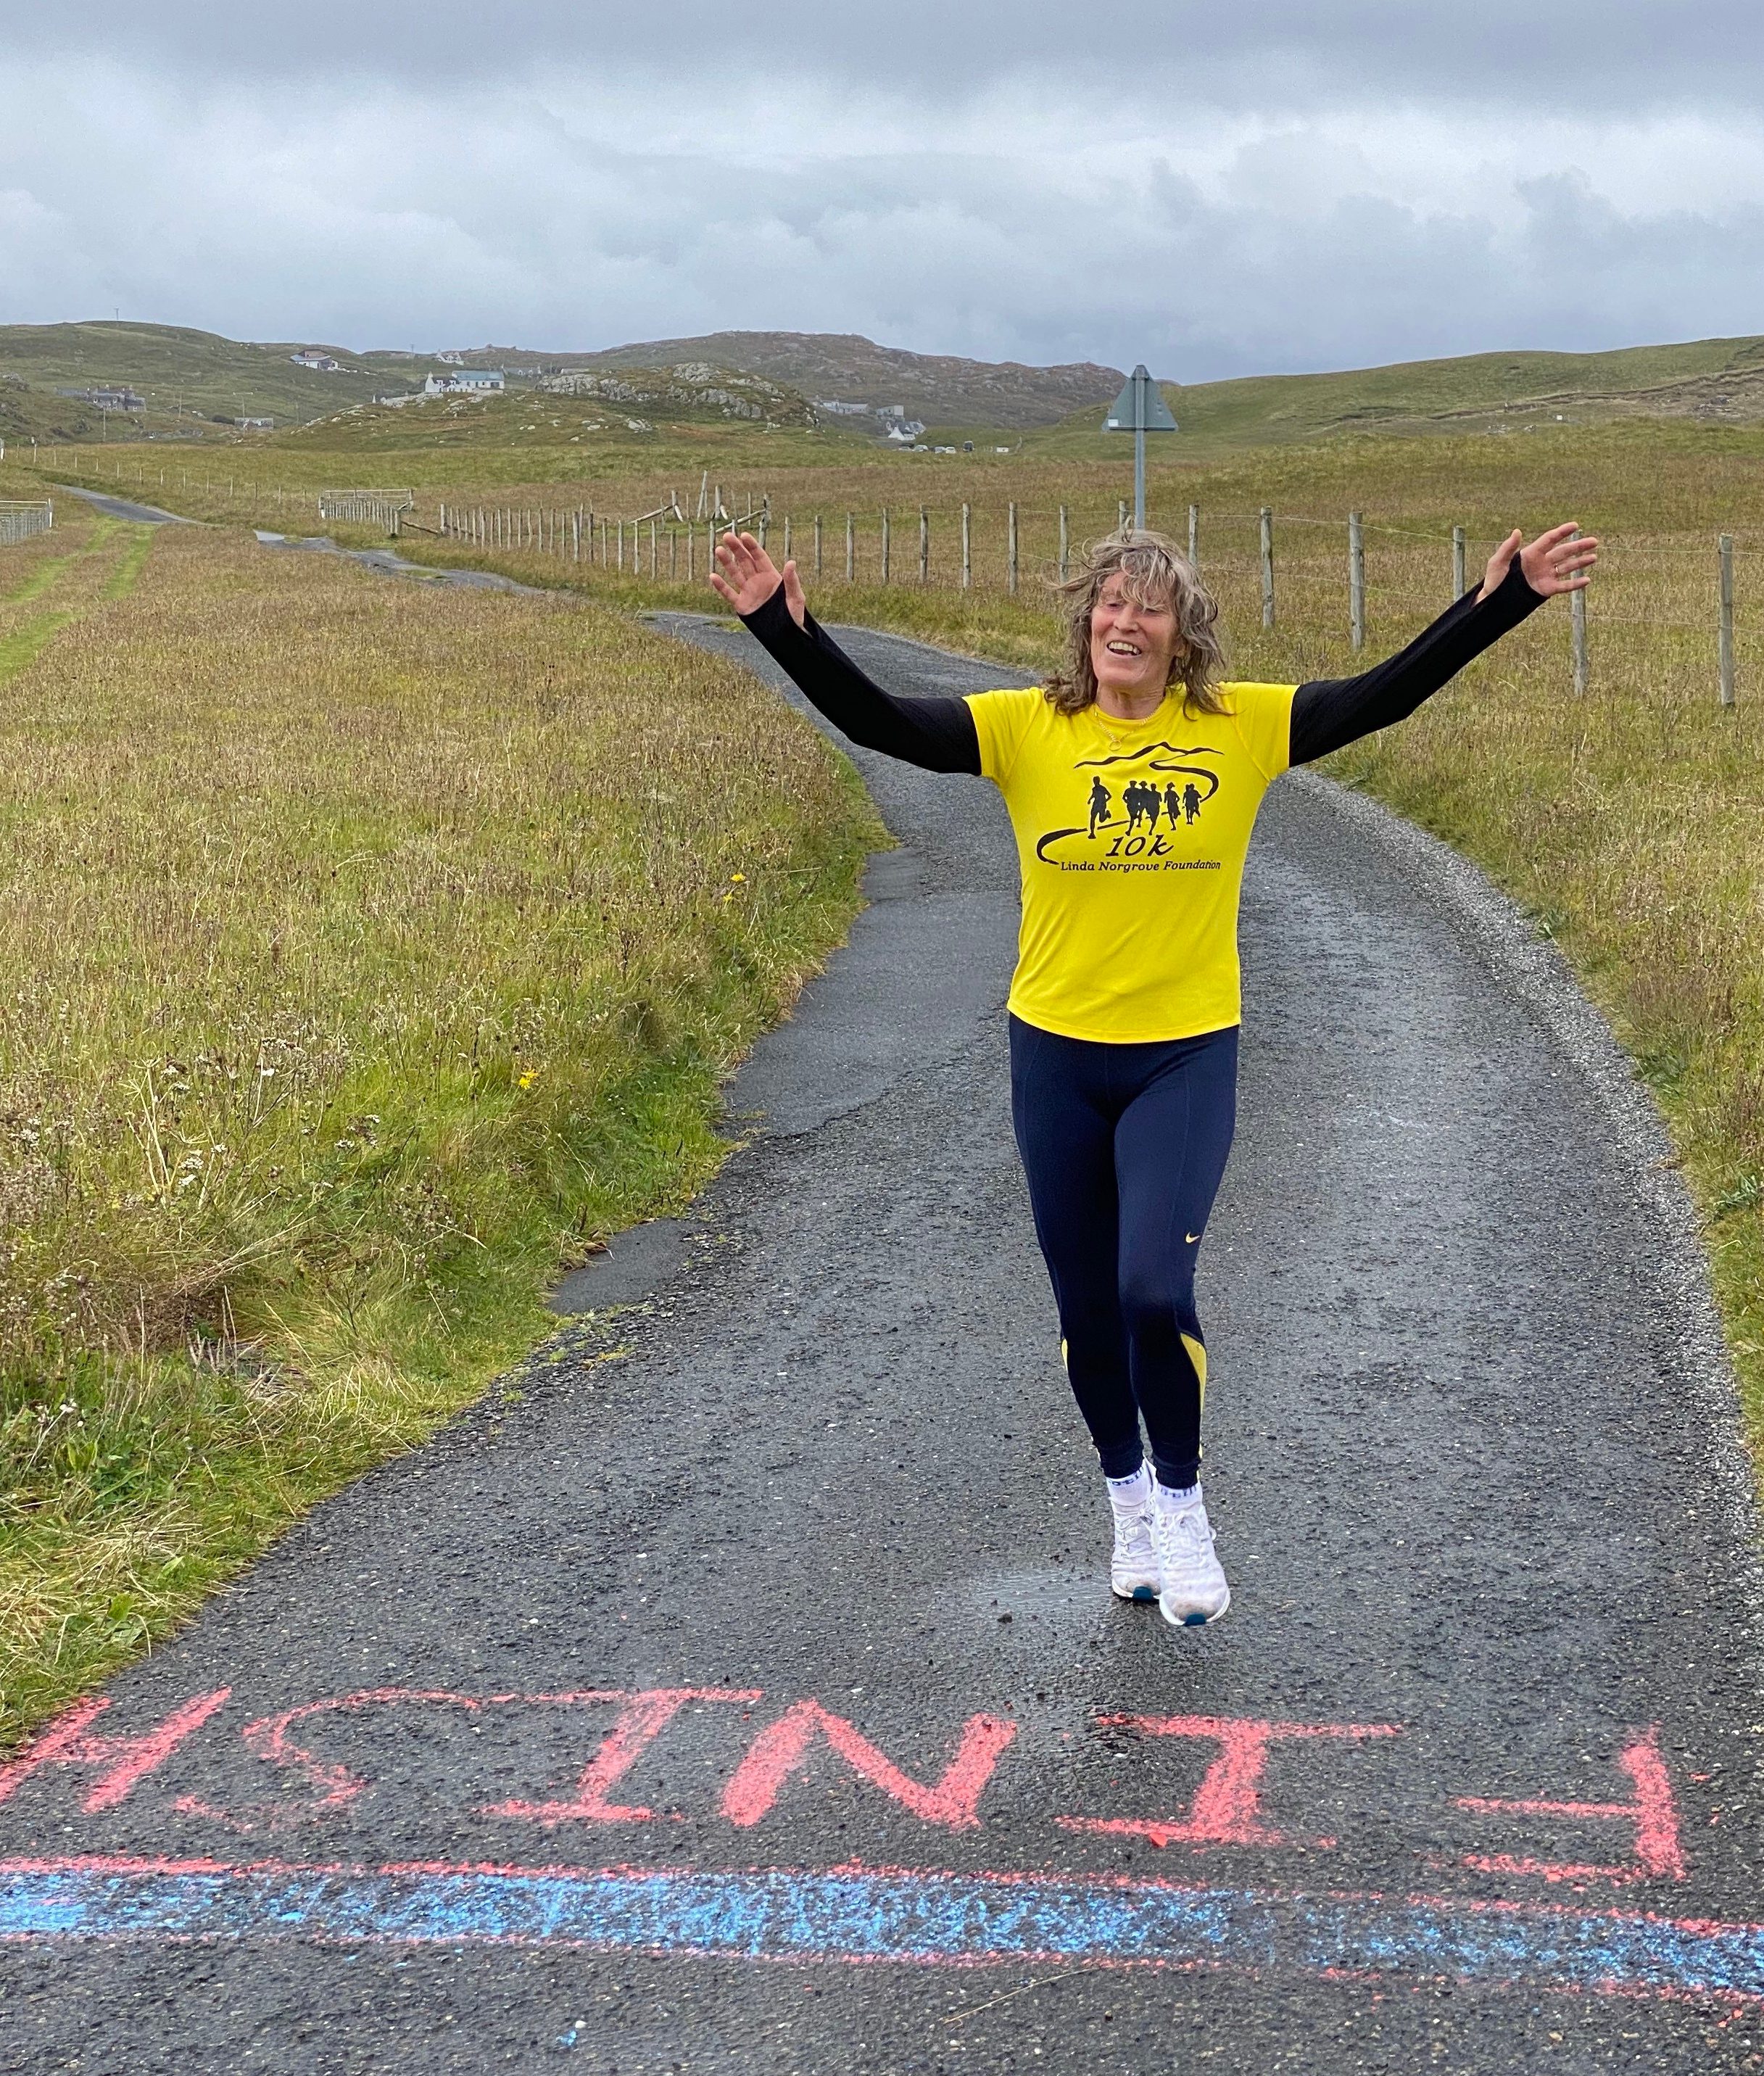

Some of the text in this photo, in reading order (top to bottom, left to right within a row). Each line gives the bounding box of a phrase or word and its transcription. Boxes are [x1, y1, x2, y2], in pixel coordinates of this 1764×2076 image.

[1105, 834, 1175, 857] 10k
[1060, 859, 1221, 873] Linda Norgrove Foundation
[0, 1686, 1686, 1882] FINISH
